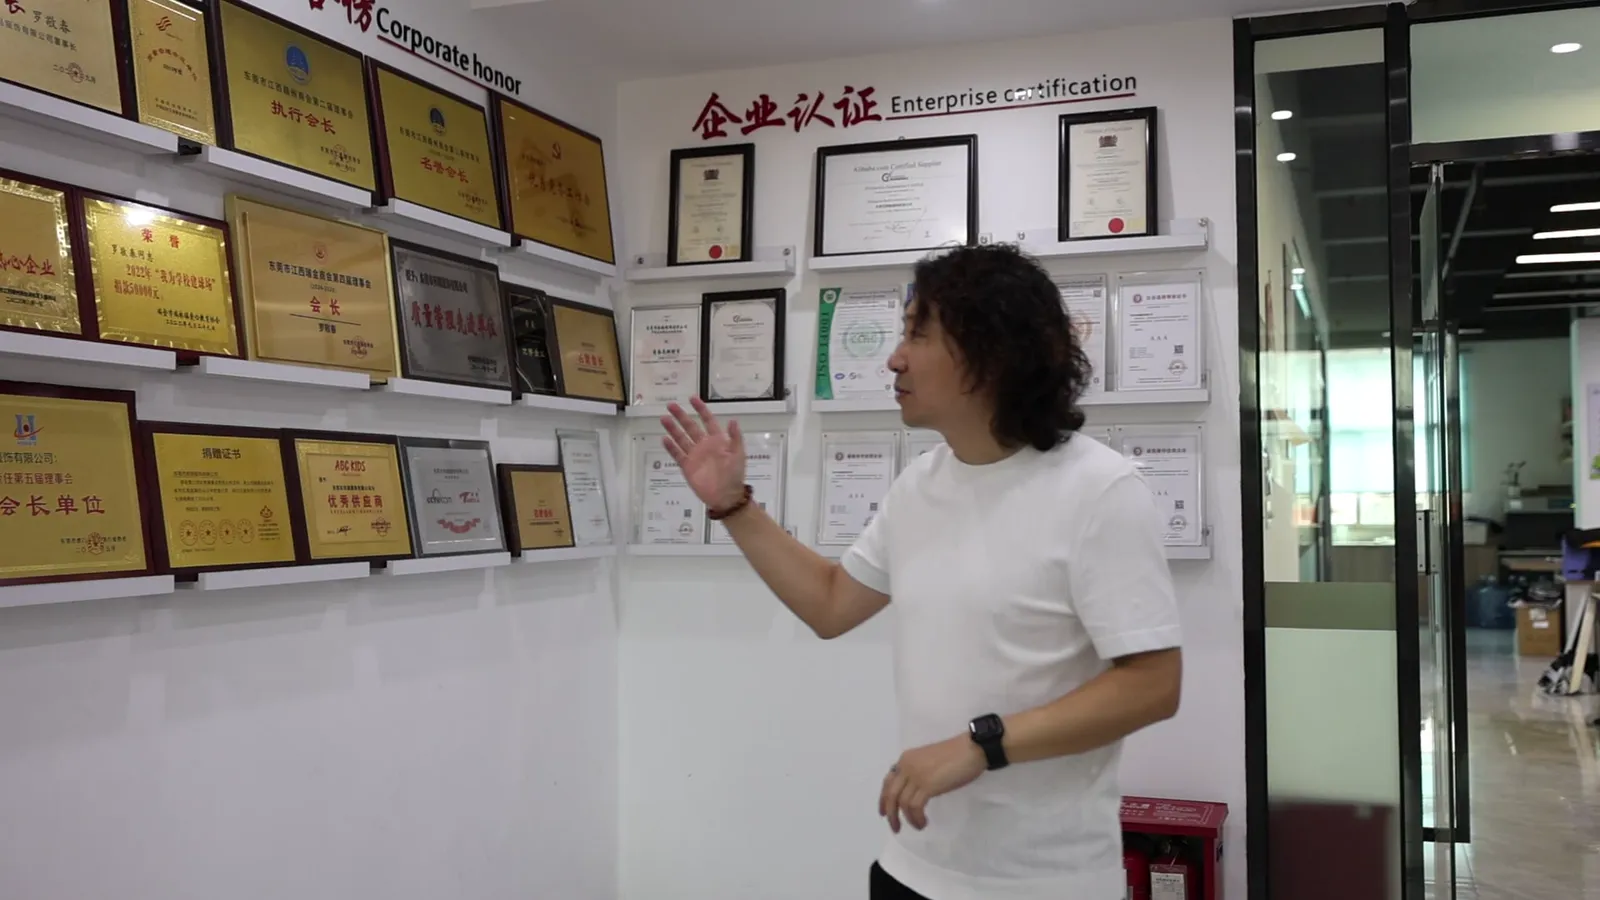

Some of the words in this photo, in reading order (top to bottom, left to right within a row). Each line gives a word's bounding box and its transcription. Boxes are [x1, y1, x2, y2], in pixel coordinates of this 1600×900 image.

[308, 0, 376, 33] 榜
[376, 8, 469, 71] Corporate
[473, 53, 522, 95] honor
[692, 85, 882, 140] 企业认证
[892, 87, 997, 115] Enterprise
[270, 99, 337, 135] 执行会长
[420, 156, 469, 184] 名誉会长
[268, 260, 373, 291] 东莞市江西瑞金商会第四届理事会
[309, 296, 341, 317] 会长
[411, 300, 498, 340] 质量管理先进单位
[0, 452, 58, 464] 饰有限公司：
[202, 447, 242, 460] 捐赠证书
[0, 472, 73, 486] 任第五届理事会
[0, 494, 106, 517] 会长单位
[328, 494, 383, 509] 优秀供应商
